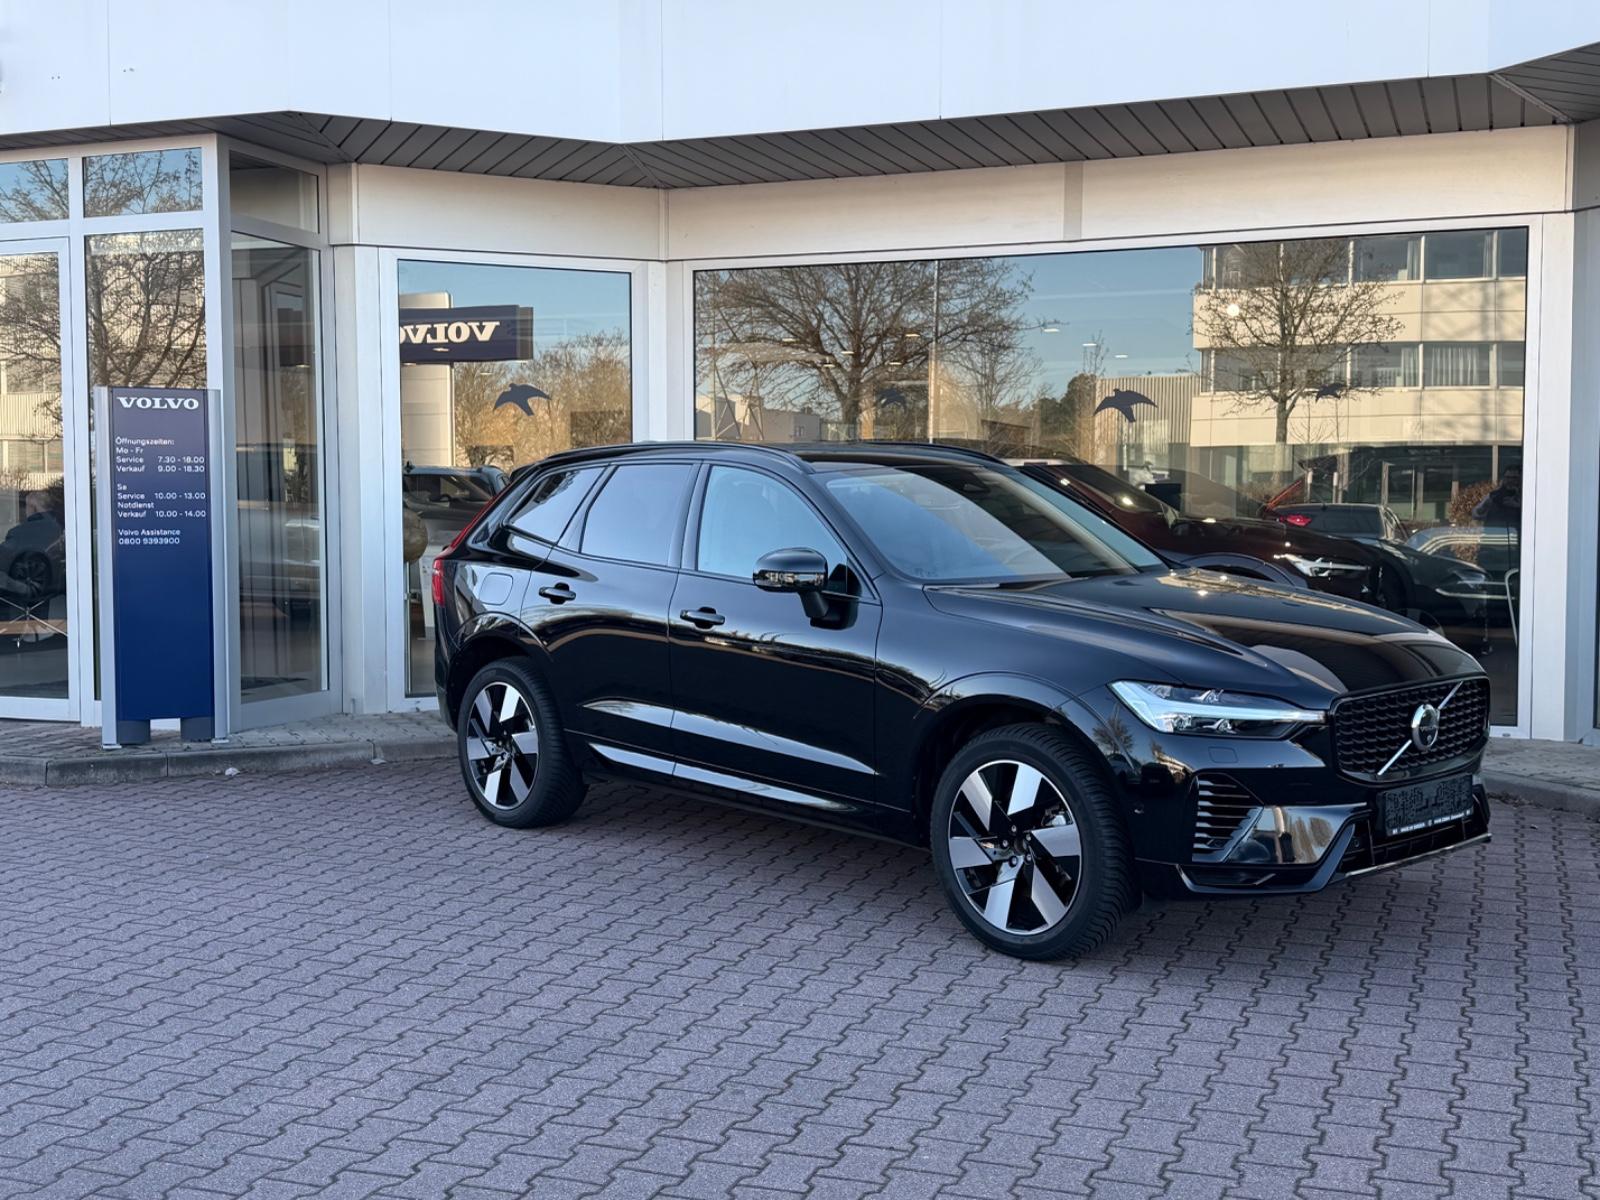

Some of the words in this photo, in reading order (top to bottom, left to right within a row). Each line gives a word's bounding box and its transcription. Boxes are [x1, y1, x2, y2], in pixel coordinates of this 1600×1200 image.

[116, 396, 200, 410] VOLVO
[115, 436, 175, 446] Öffnungszeiten:
[117, 492, 145, 500] Service
[118, 537, 141, 545] 0800
